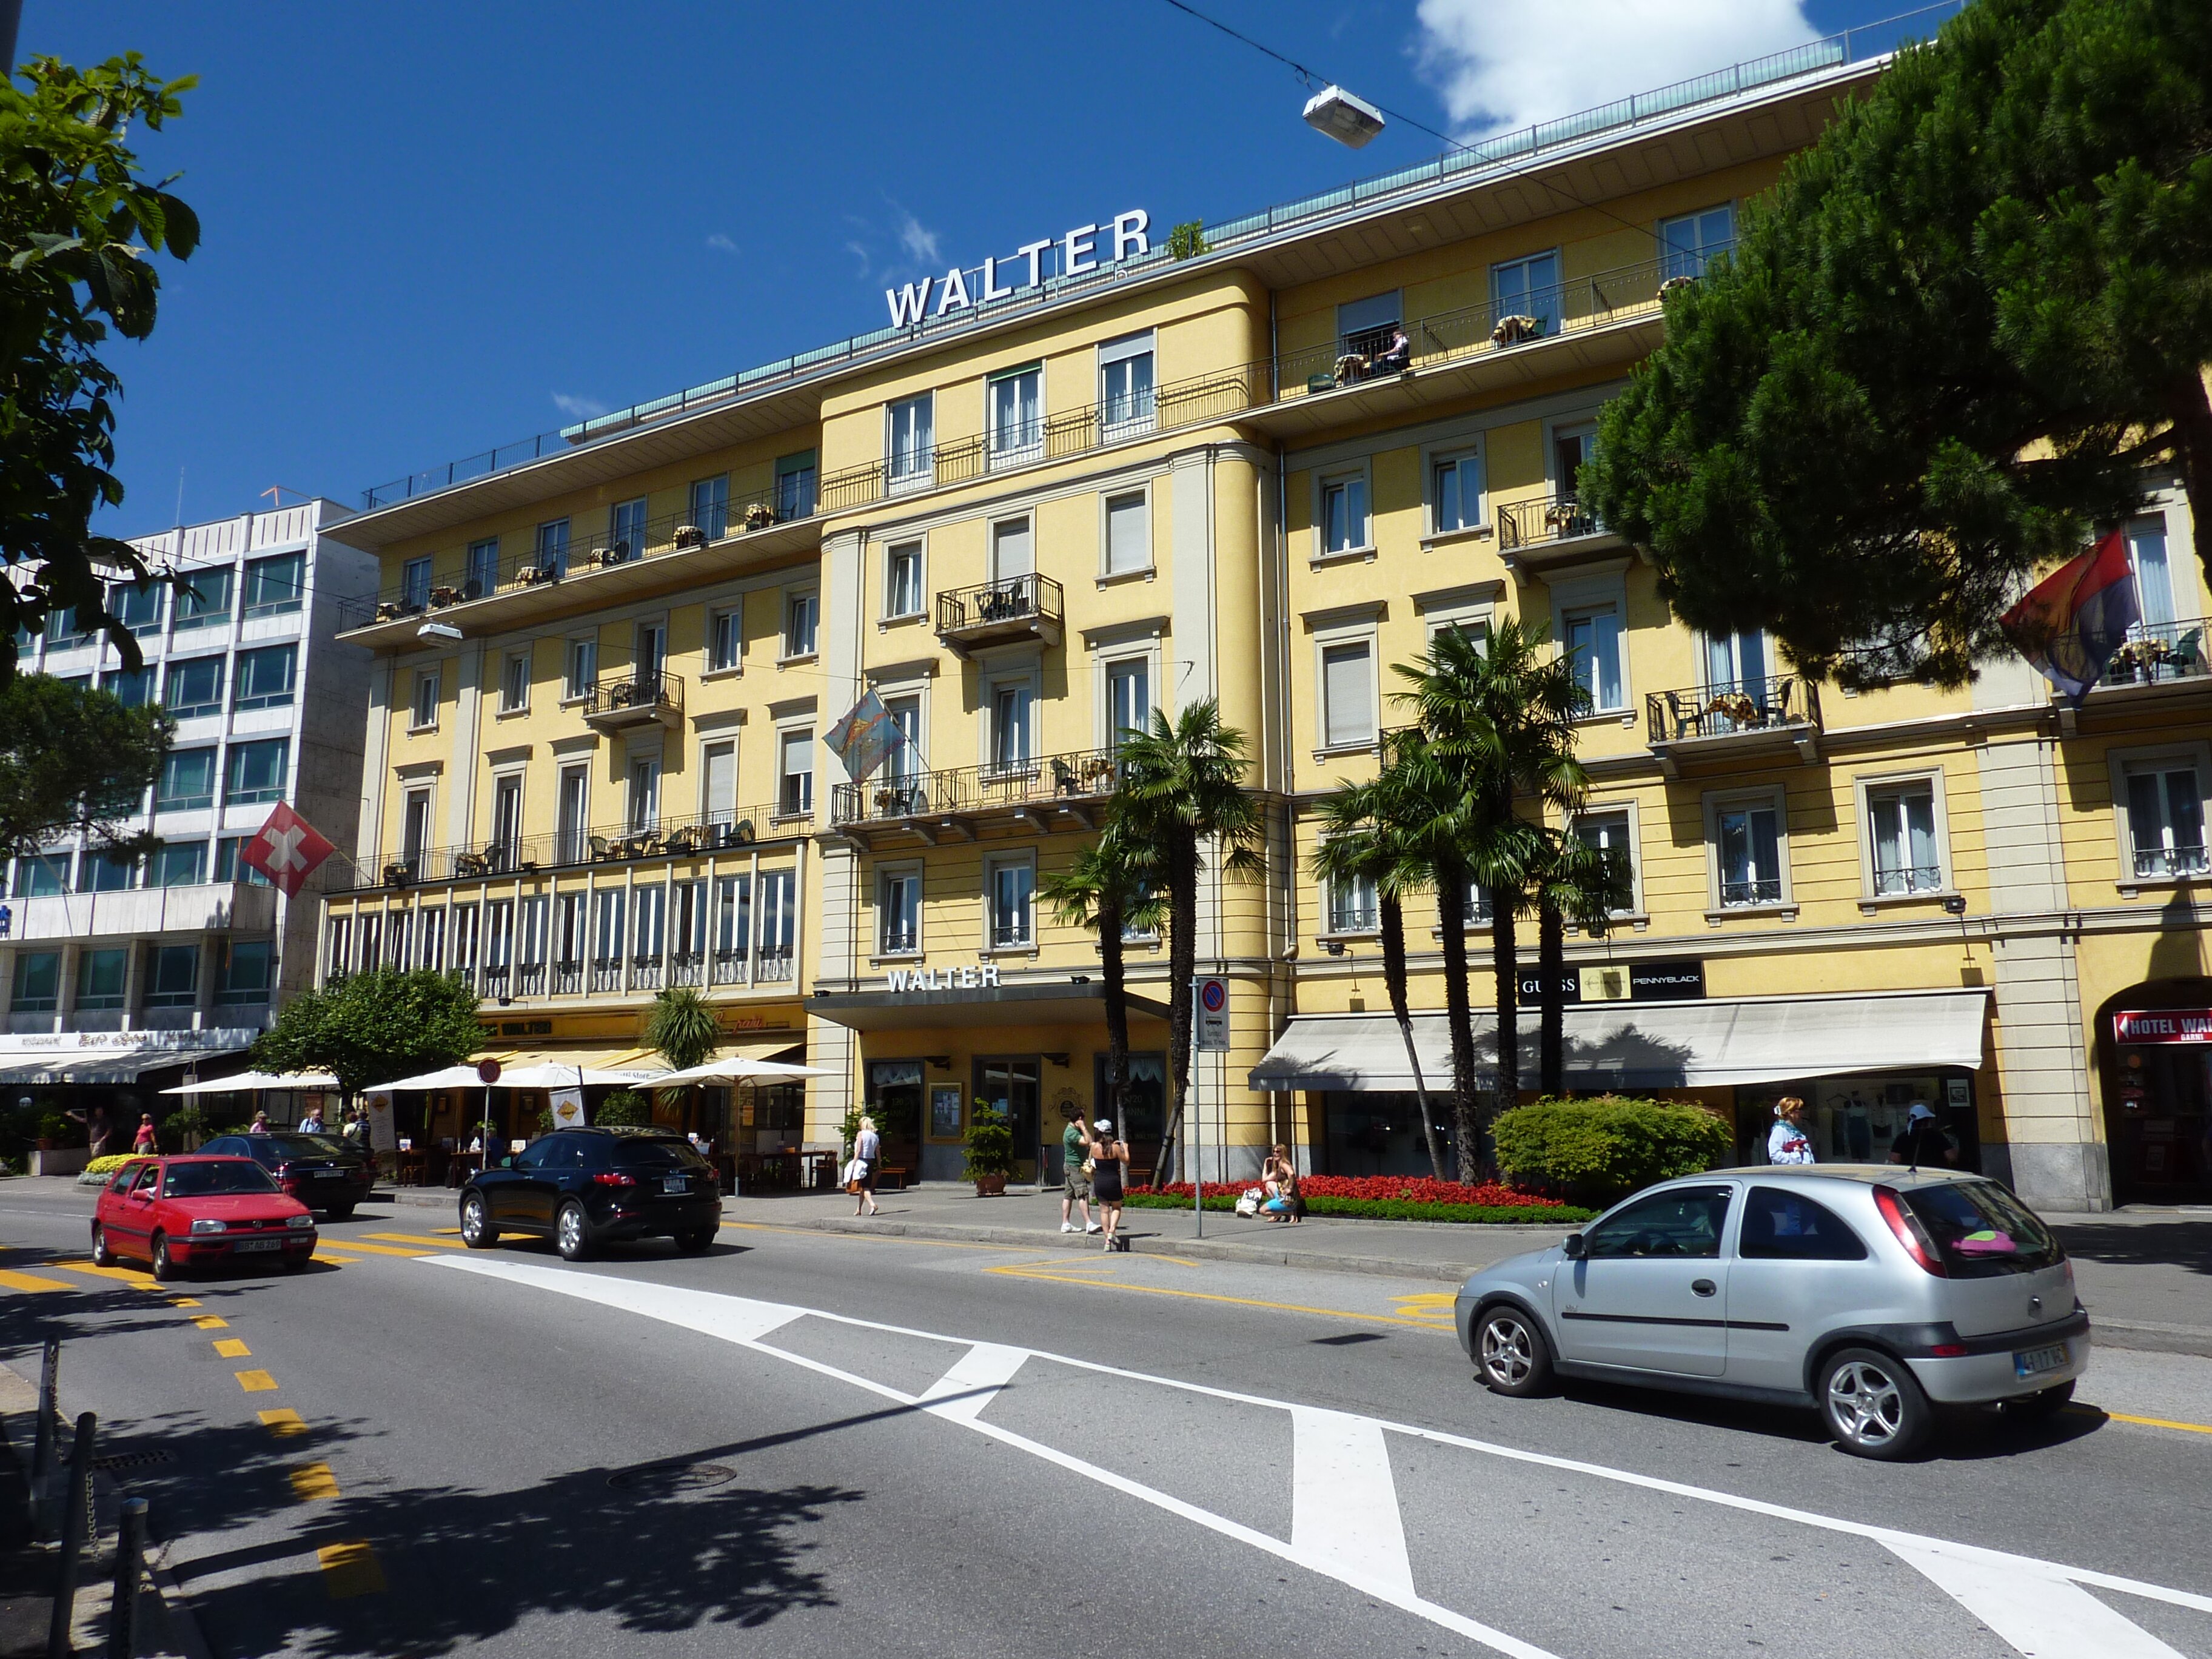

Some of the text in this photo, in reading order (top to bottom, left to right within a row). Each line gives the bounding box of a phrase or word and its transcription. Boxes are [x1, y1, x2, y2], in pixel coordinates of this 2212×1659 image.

[886, 209, 1150, 329] WALTER
[888, 964, 1002, 993] WALTER
[1523, 978, 1575, 993] GUS
[1633, 976, 1700, 985] PENNYBLACK
[2130, 1019, 2177, 1034] HOTEL
[1126, 1107, 1145, 1116] ANNI
